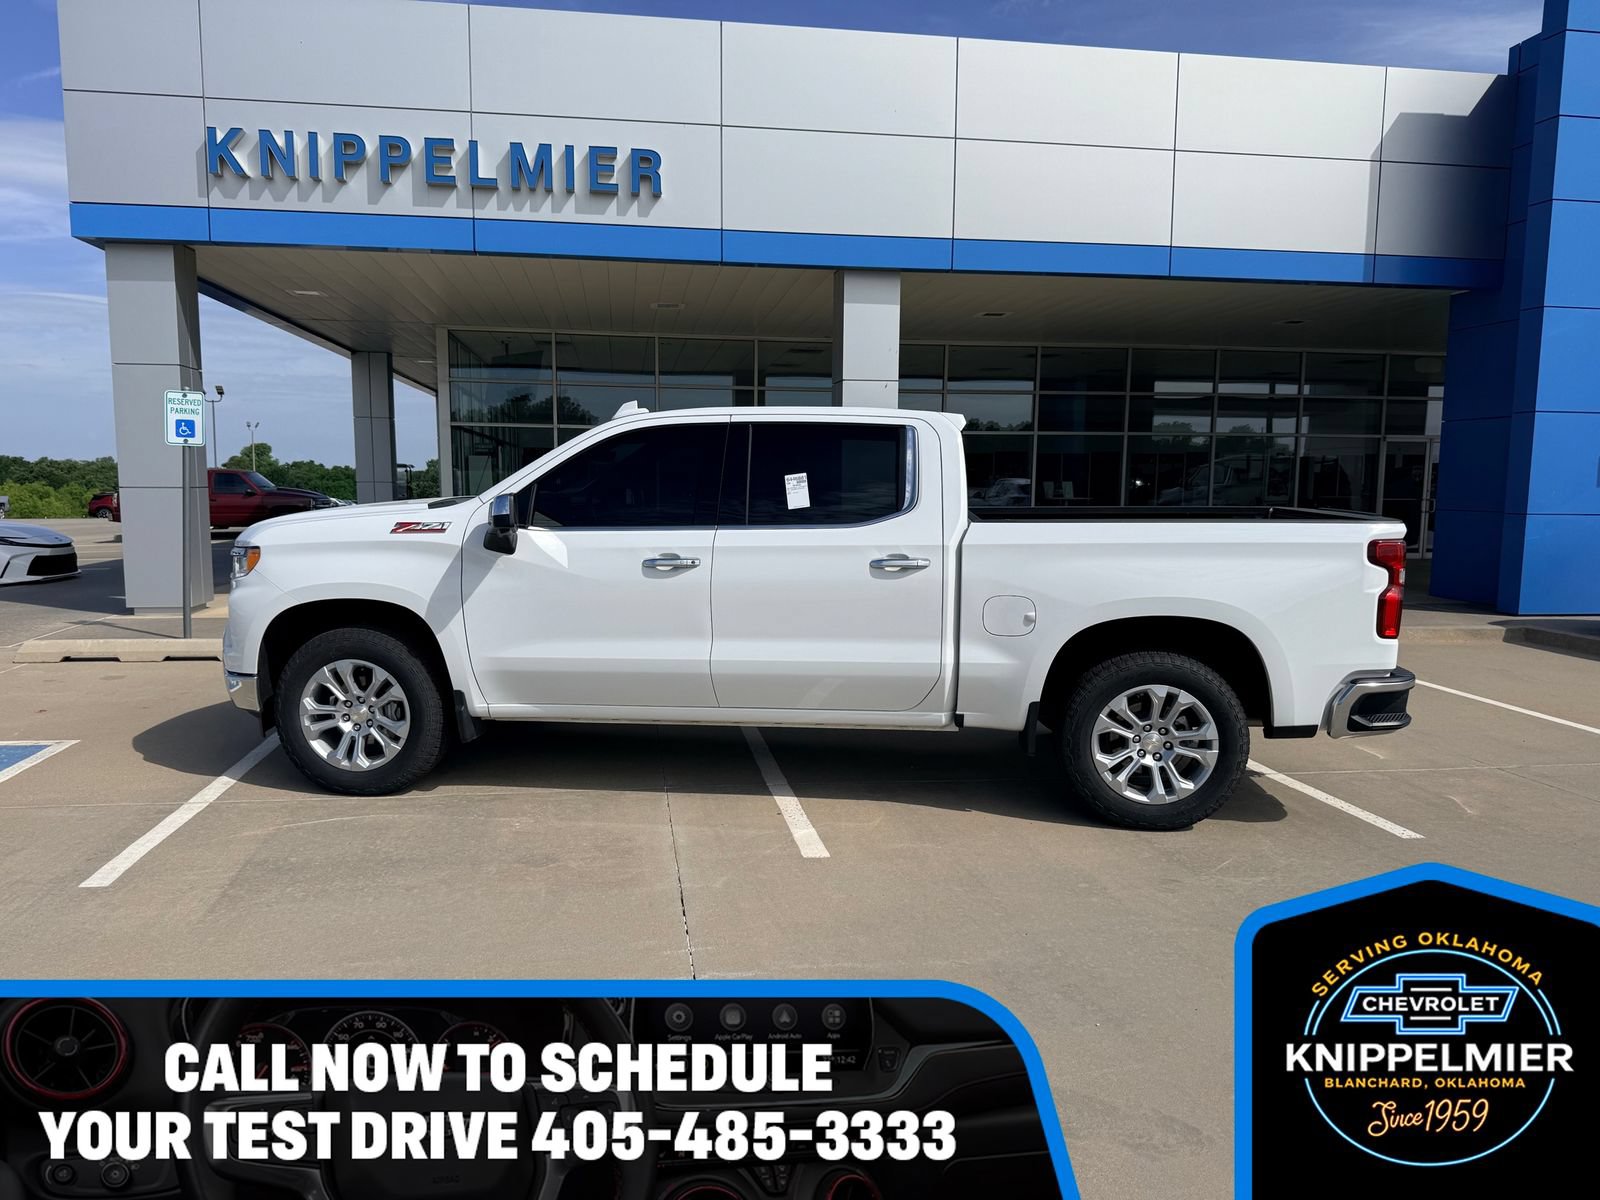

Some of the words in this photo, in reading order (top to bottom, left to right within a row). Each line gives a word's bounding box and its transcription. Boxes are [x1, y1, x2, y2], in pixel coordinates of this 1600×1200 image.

[206, 126, 663, 198] KNIPPELMIER
[168, 398, 201, 406] RESERVED
[170, 407, 200, 415] PARKING
[390, 521, 452, 534] Z71
